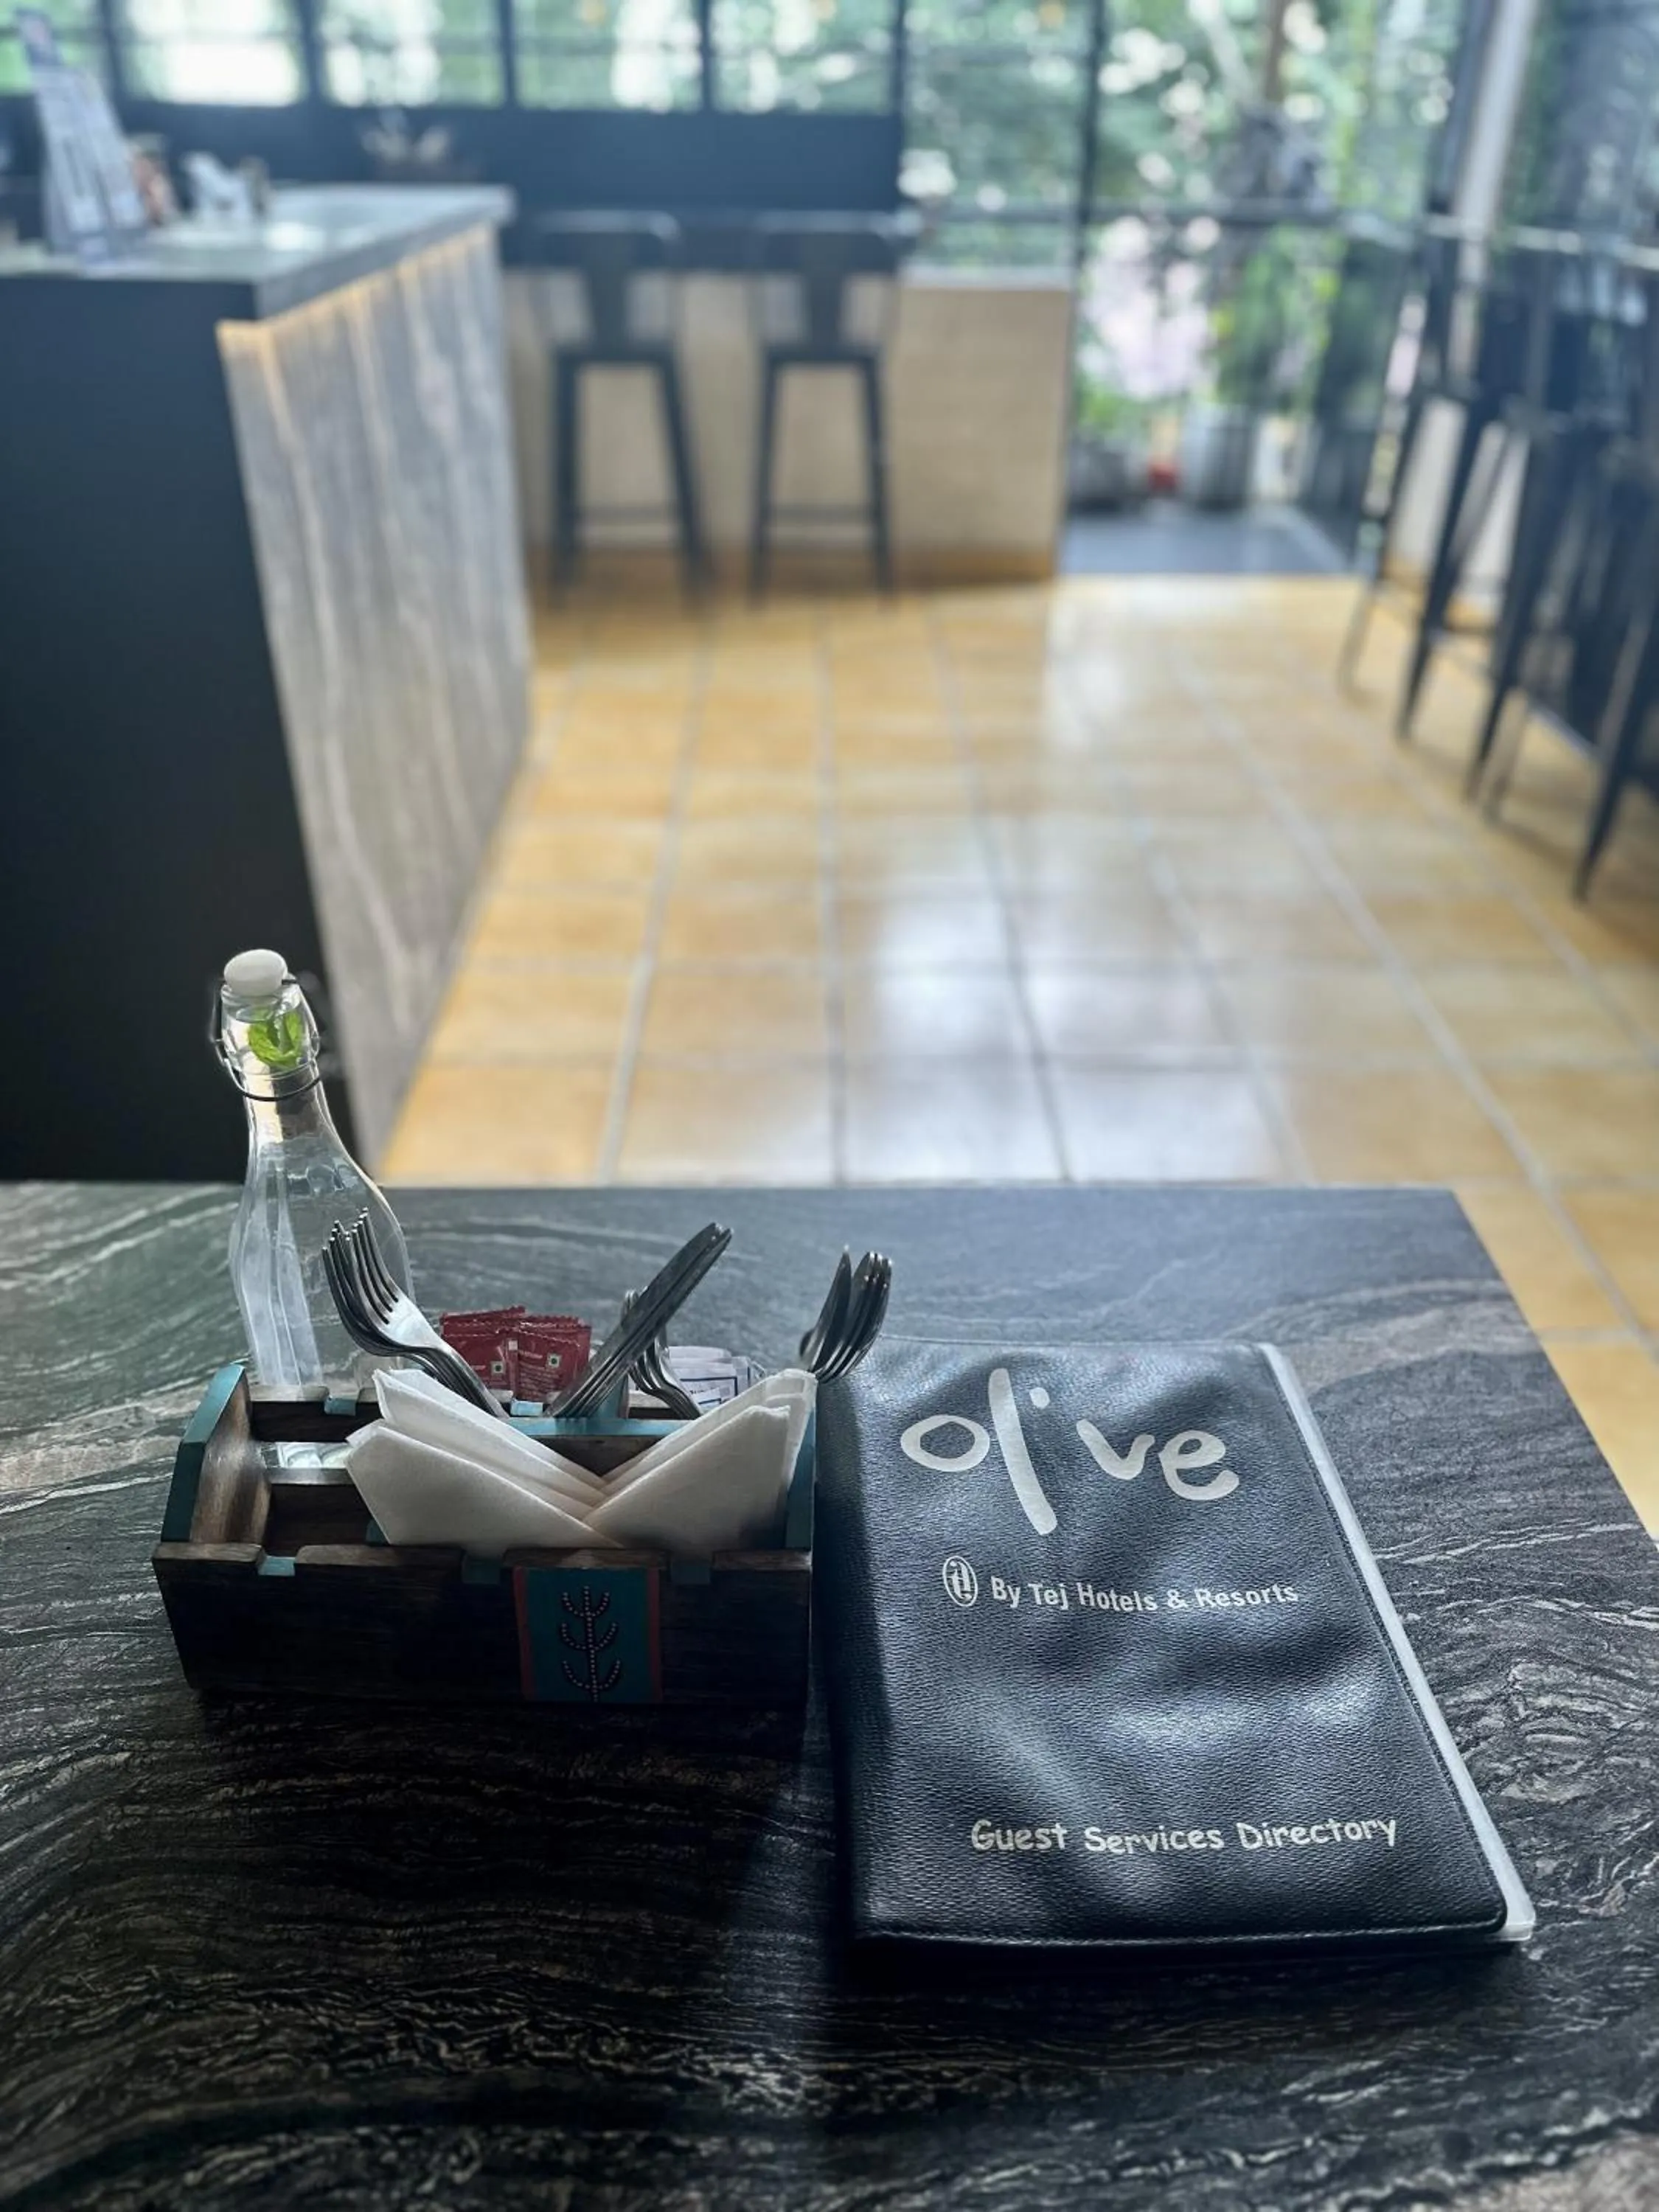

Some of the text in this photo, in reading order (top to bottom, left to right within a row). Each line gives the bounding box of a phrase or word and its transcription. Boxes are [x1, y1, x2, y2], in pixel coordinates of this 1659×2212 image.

[991, 1576, 1298, 1613] By Tej Hotels & Resorts
[971, 1817, 1397, 1854] Guest Services Directory
